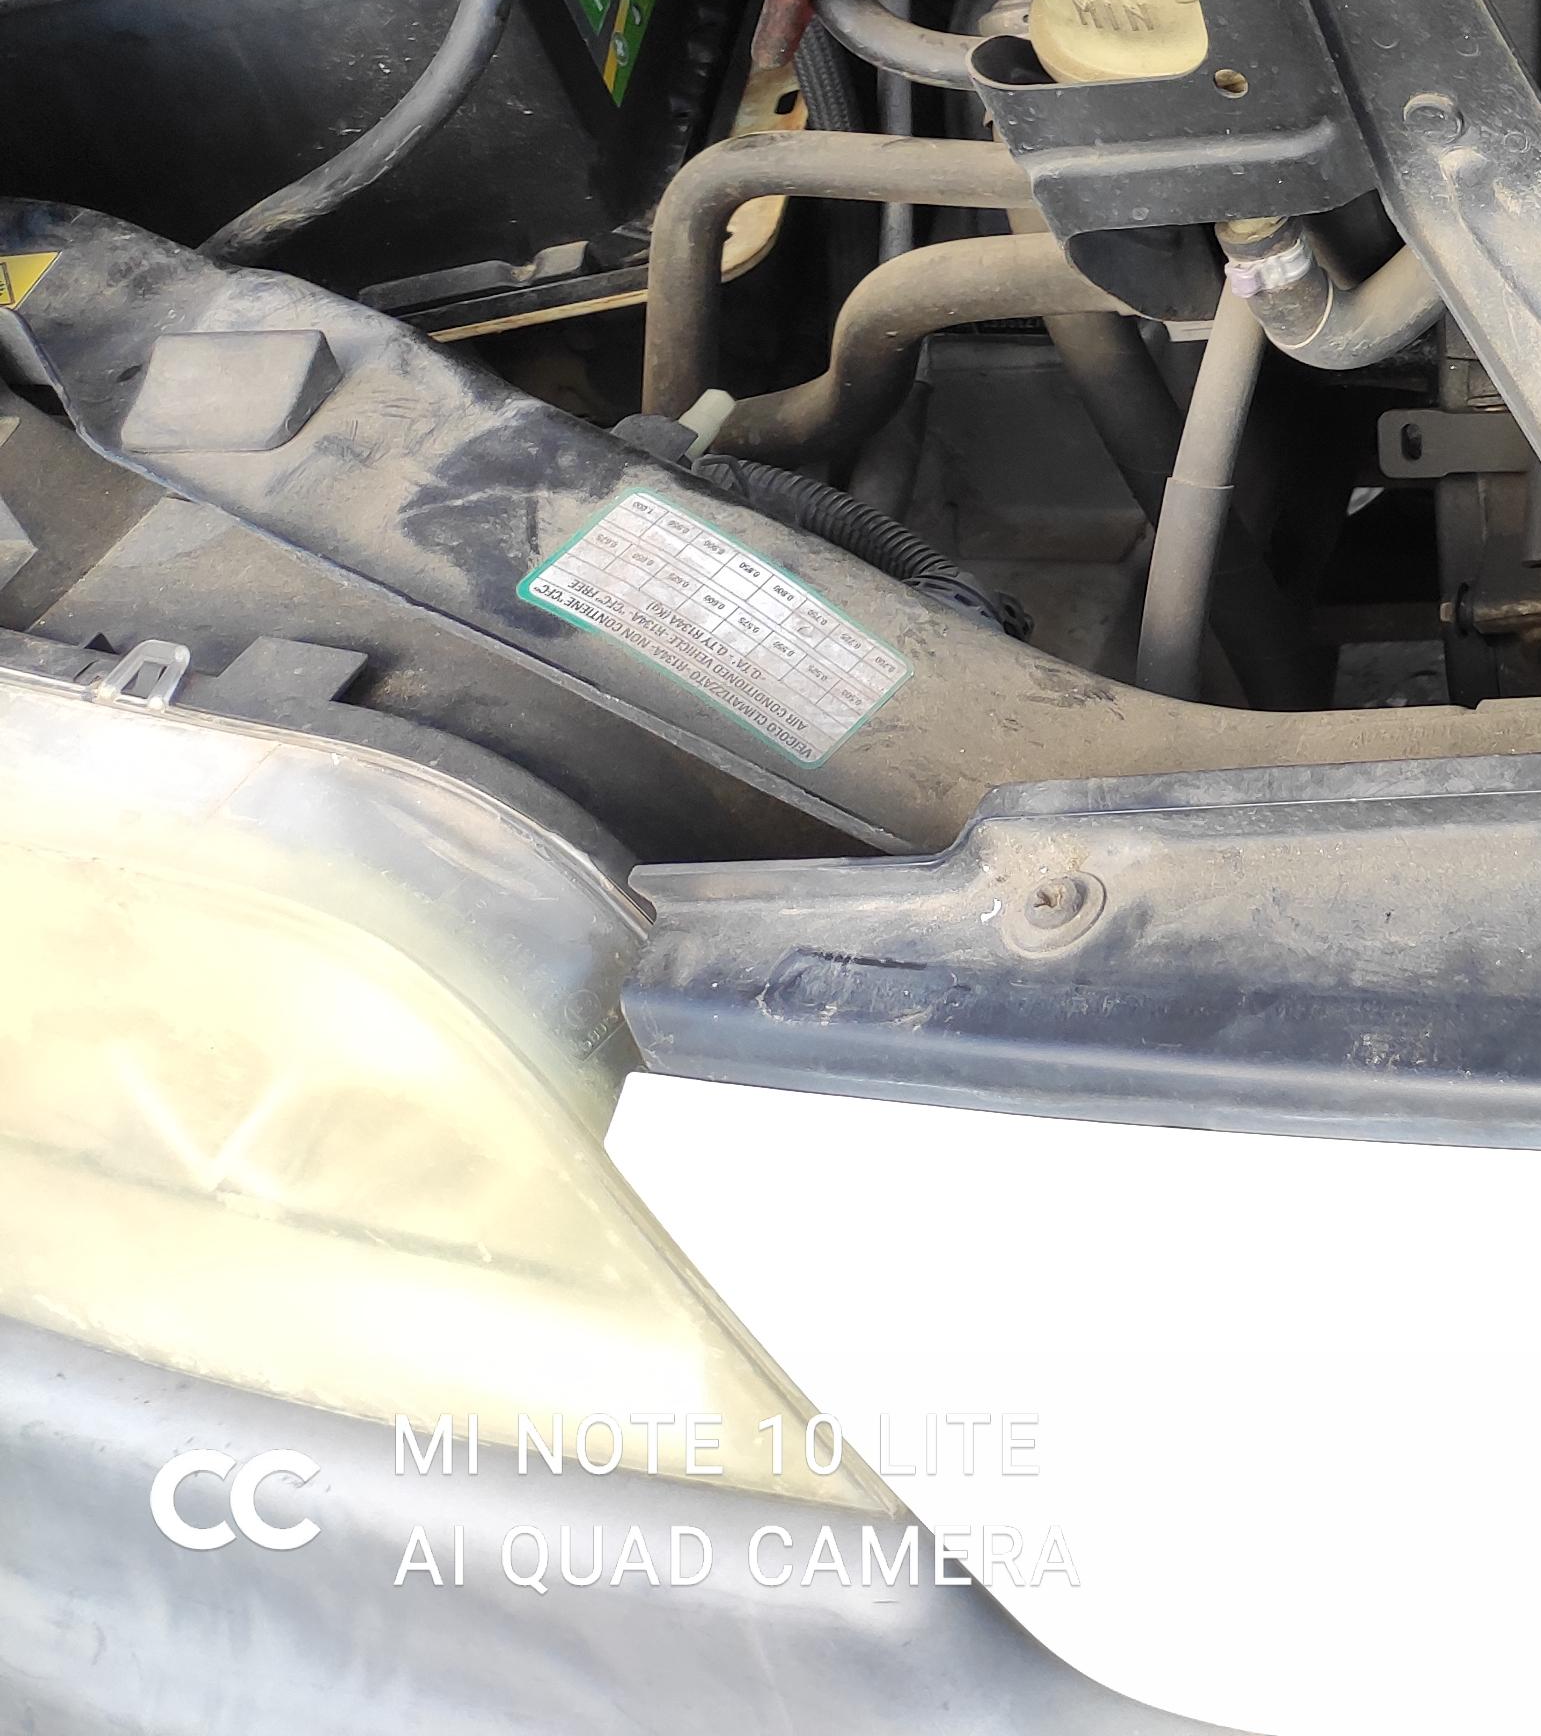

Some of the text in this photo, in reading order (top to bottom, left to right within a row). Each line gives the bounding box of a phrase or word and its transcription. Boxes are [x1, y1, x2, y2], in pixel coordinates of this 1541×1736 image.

[566, 578, 599, 599] FREE
[563, 596, 624, 632] CONTIENE
[644, 600, 672, 620] (Kg)
[620, 627, 651, 648] NON
[666, 614, 704, 639] R134A
[666, 634, 715, 668] VEHICLE
[687, 669, 769, 726] CLIMATIZZATO
[711, 663, 788, 718] CONDITIONED
[783, 713, 809, 731] AIR
[764, 721, 814, 758] VEICOLO
